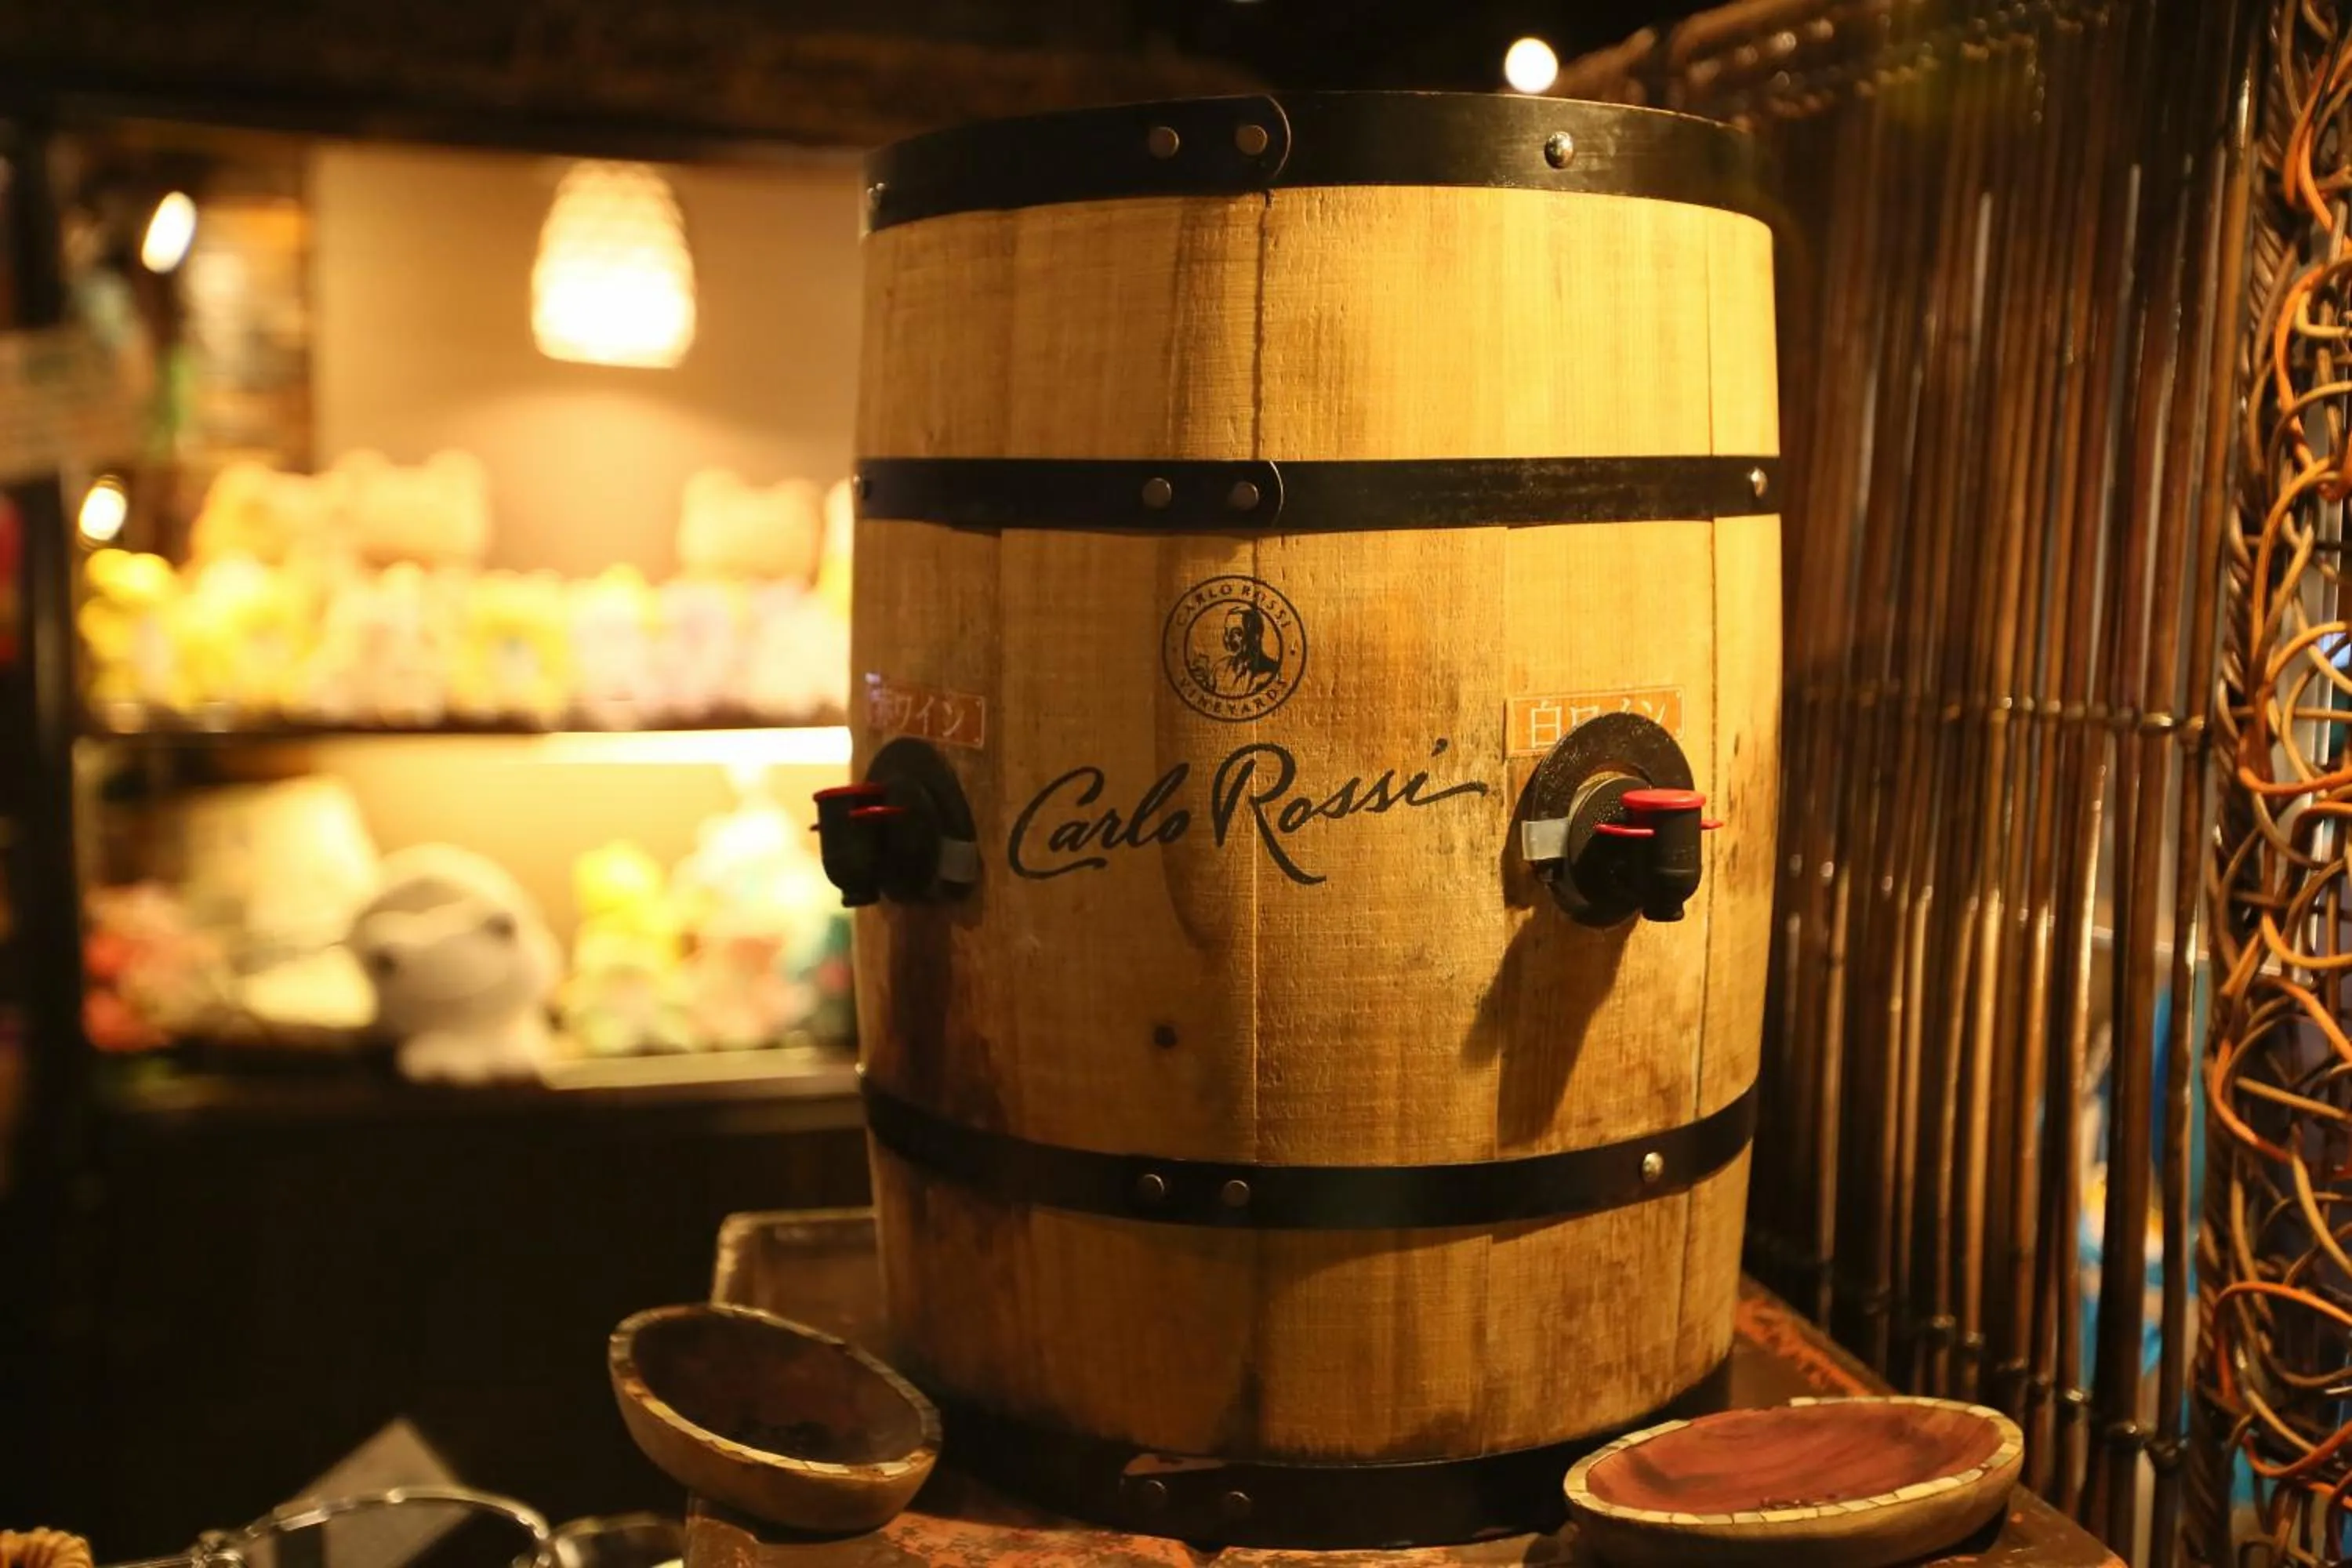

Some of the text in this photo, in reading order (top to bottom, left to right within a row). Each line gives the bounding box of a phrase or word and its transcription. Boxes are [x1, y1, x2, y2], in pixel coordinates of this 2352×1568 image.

[1176, 583, 1291, 628] CARLO ROSSI
[1007, 738, 1488, 885] Carlo Rossi
